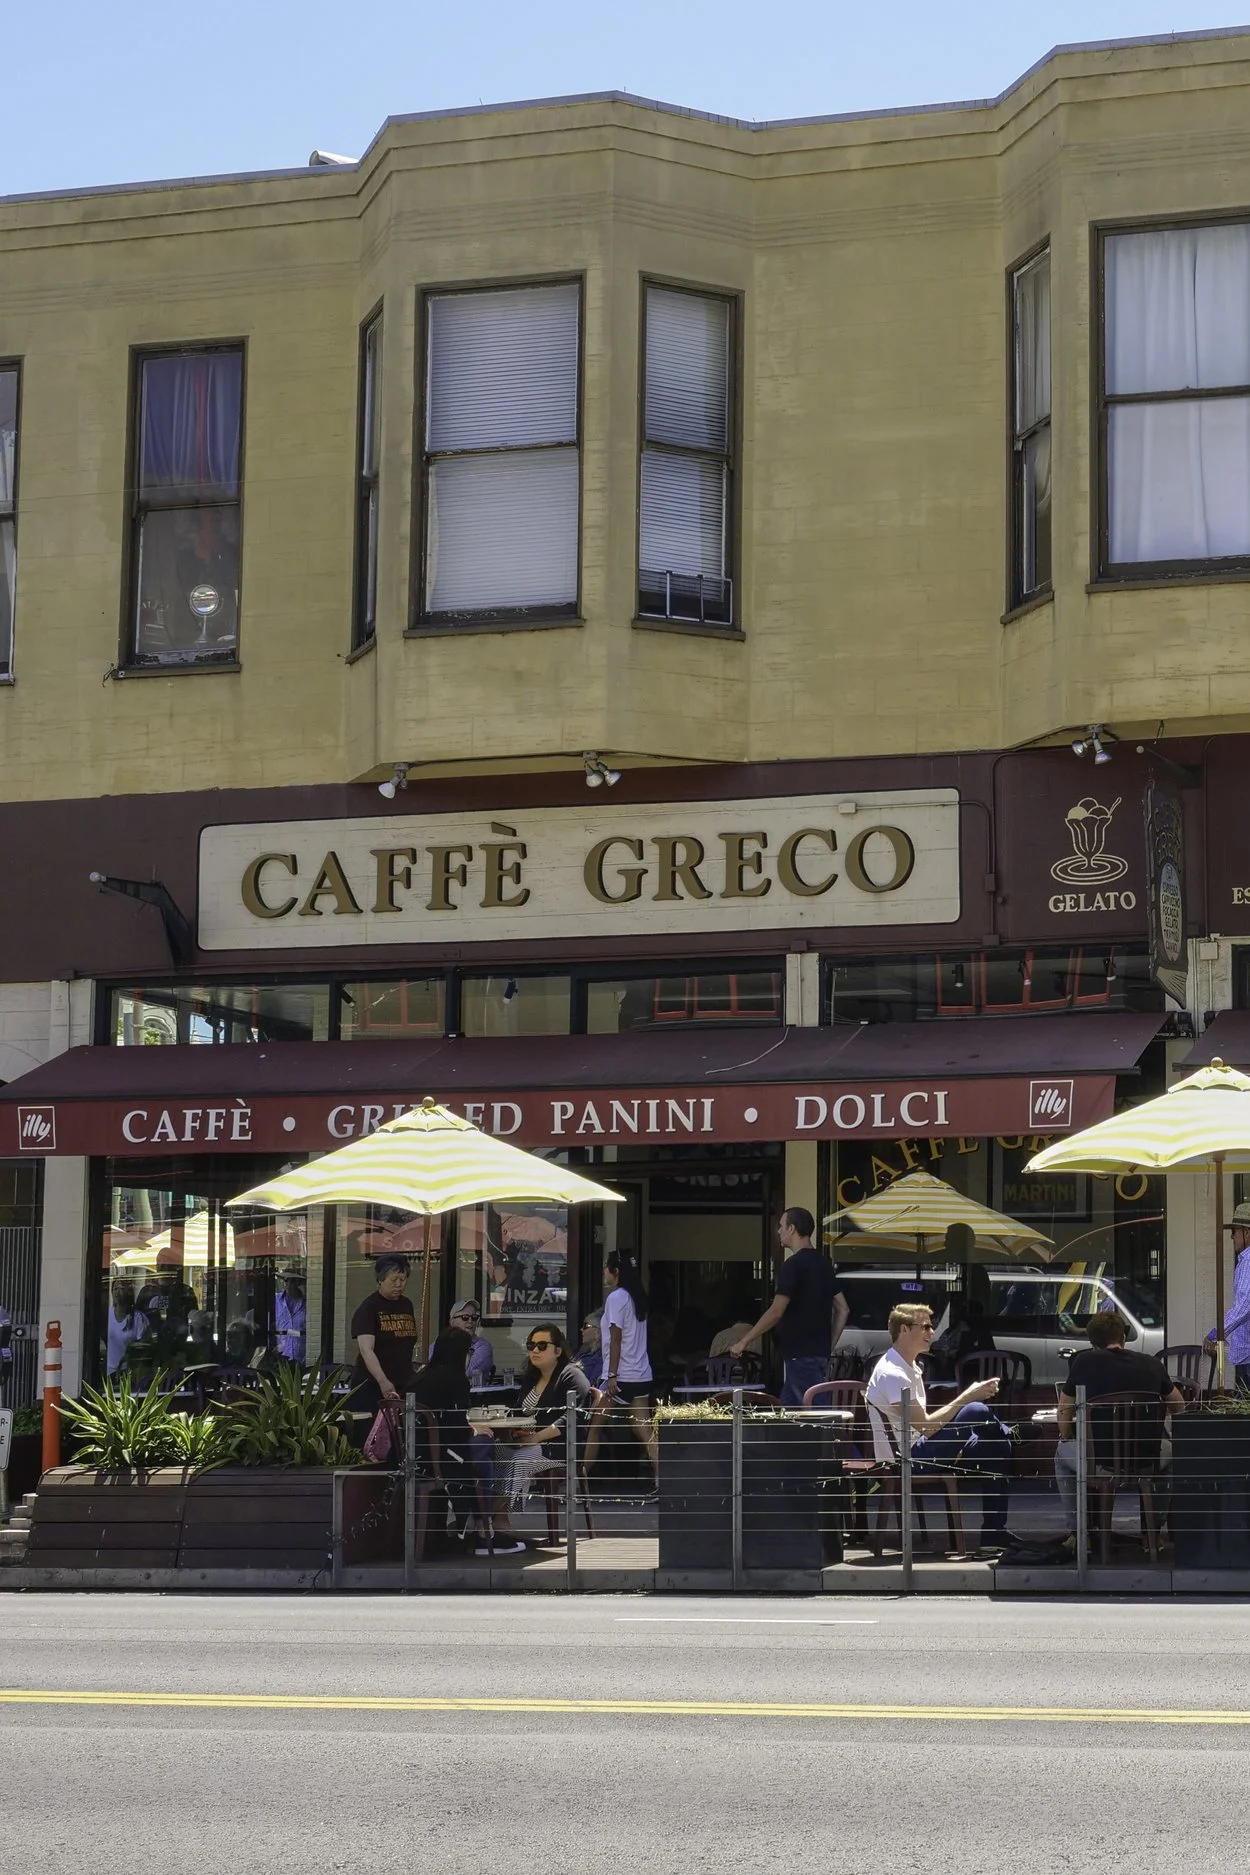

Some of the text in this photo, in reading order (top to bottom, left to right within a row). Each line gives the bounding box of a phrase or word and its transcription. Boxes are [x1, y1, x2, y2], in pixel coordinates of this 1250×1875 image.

[241, 821, 916, 919] CAFFÈ GRECO
[1048, 890, 1137, 913] GELATO
[1033, 1088, 1066, 1117] illy
[23, 1114, 51, 1142] illy
[122, 1091, 950, 1143] CAFFÈ GRED PANINI DOLCI
[1004, 1184, 1075, 1203] MARTINI
